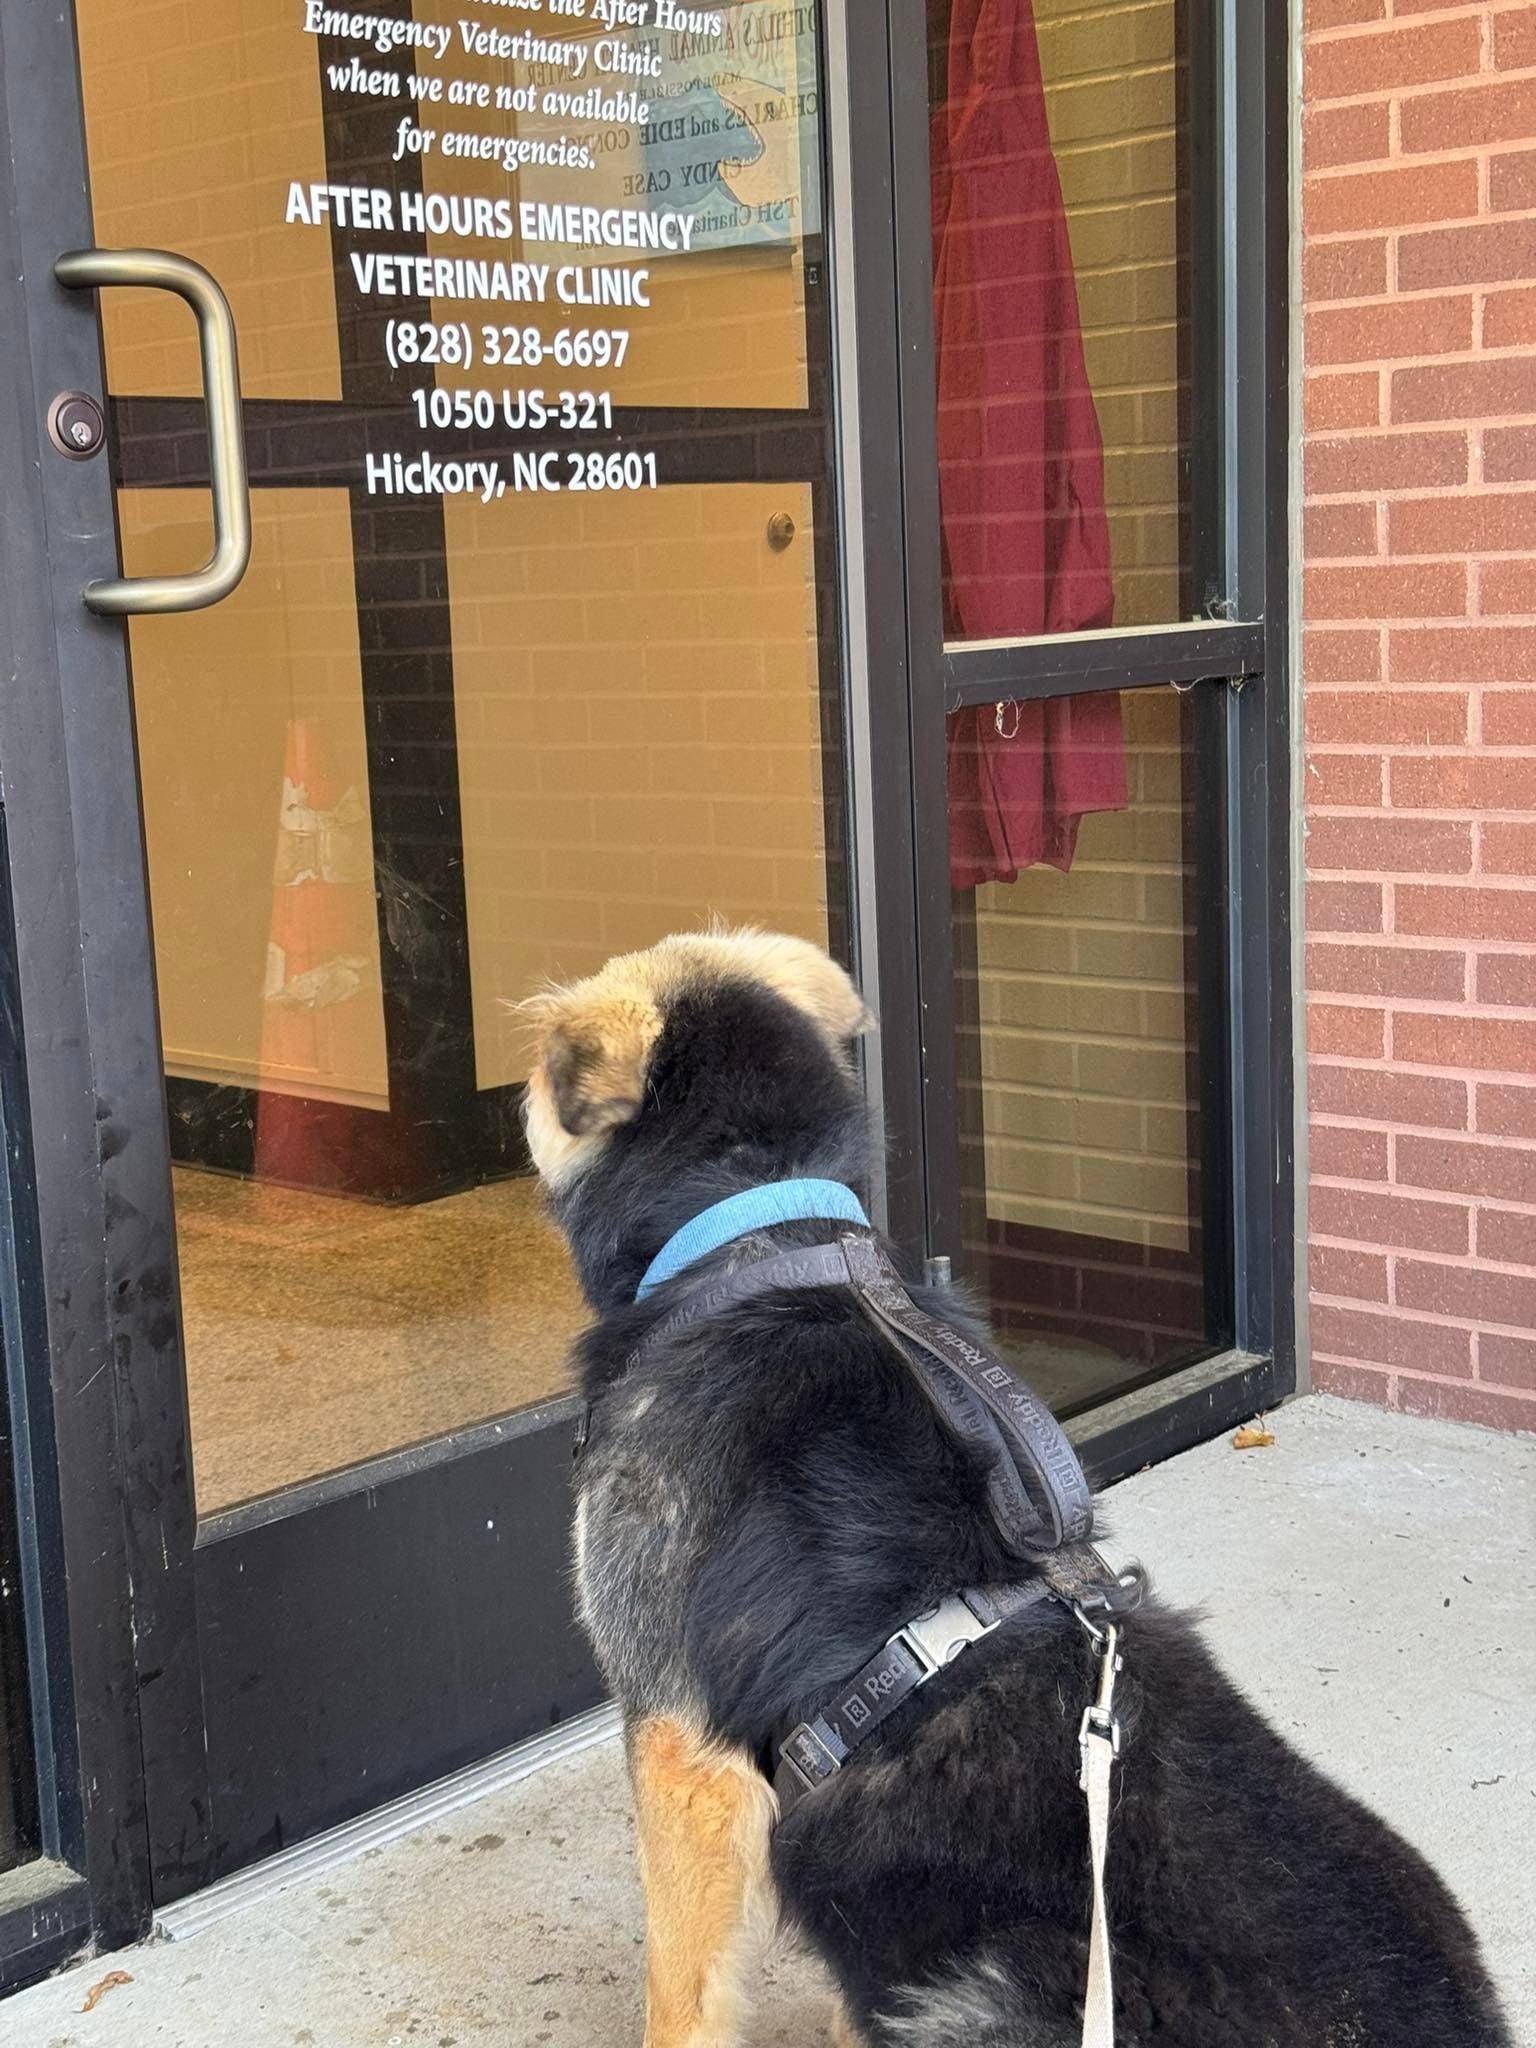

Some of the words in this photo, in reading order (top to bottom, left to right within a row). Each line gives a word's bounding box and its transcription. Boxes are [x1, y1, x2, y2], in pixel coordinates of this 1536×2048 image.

[303, 0, 452, 59] Emergency
[458, 20, 588, 77] Veterinary
[593, 39, 663, 78] Clinic
[590, 0, 649, 31] After
[653, 0, 722, 37] Hours
[326, 57, 400, 97] when
[406, 75, 443, 102] we
[448, 80, 490, 107] are
[495, 84, 537, 113] not
[542, 87, 649, 125] available
[392, 117, 436, 161] for
[441, 133, 596, 172] emergencies.
[285, 182, 394, 231] AFTER
[400, 191, 513, 239] HOURS
[519, 201, 696, 251] EMERGENCY
[350, 253, 550, 302] VETERINARY
[556, 265, 650, 307] CLINIC
[385, 319, 473, 370] (828)
[481, 325, 629, 367] 328-6697
[412, 388, 495, 429] 1050
[502, 389, 612, 429] US-321
[365, 451, 506, 504] Hickory,
[513, 452, 561, 492] NC
[567, 452, 657, 491] 28601
[929, 1323, 988, 1367] Reddy
